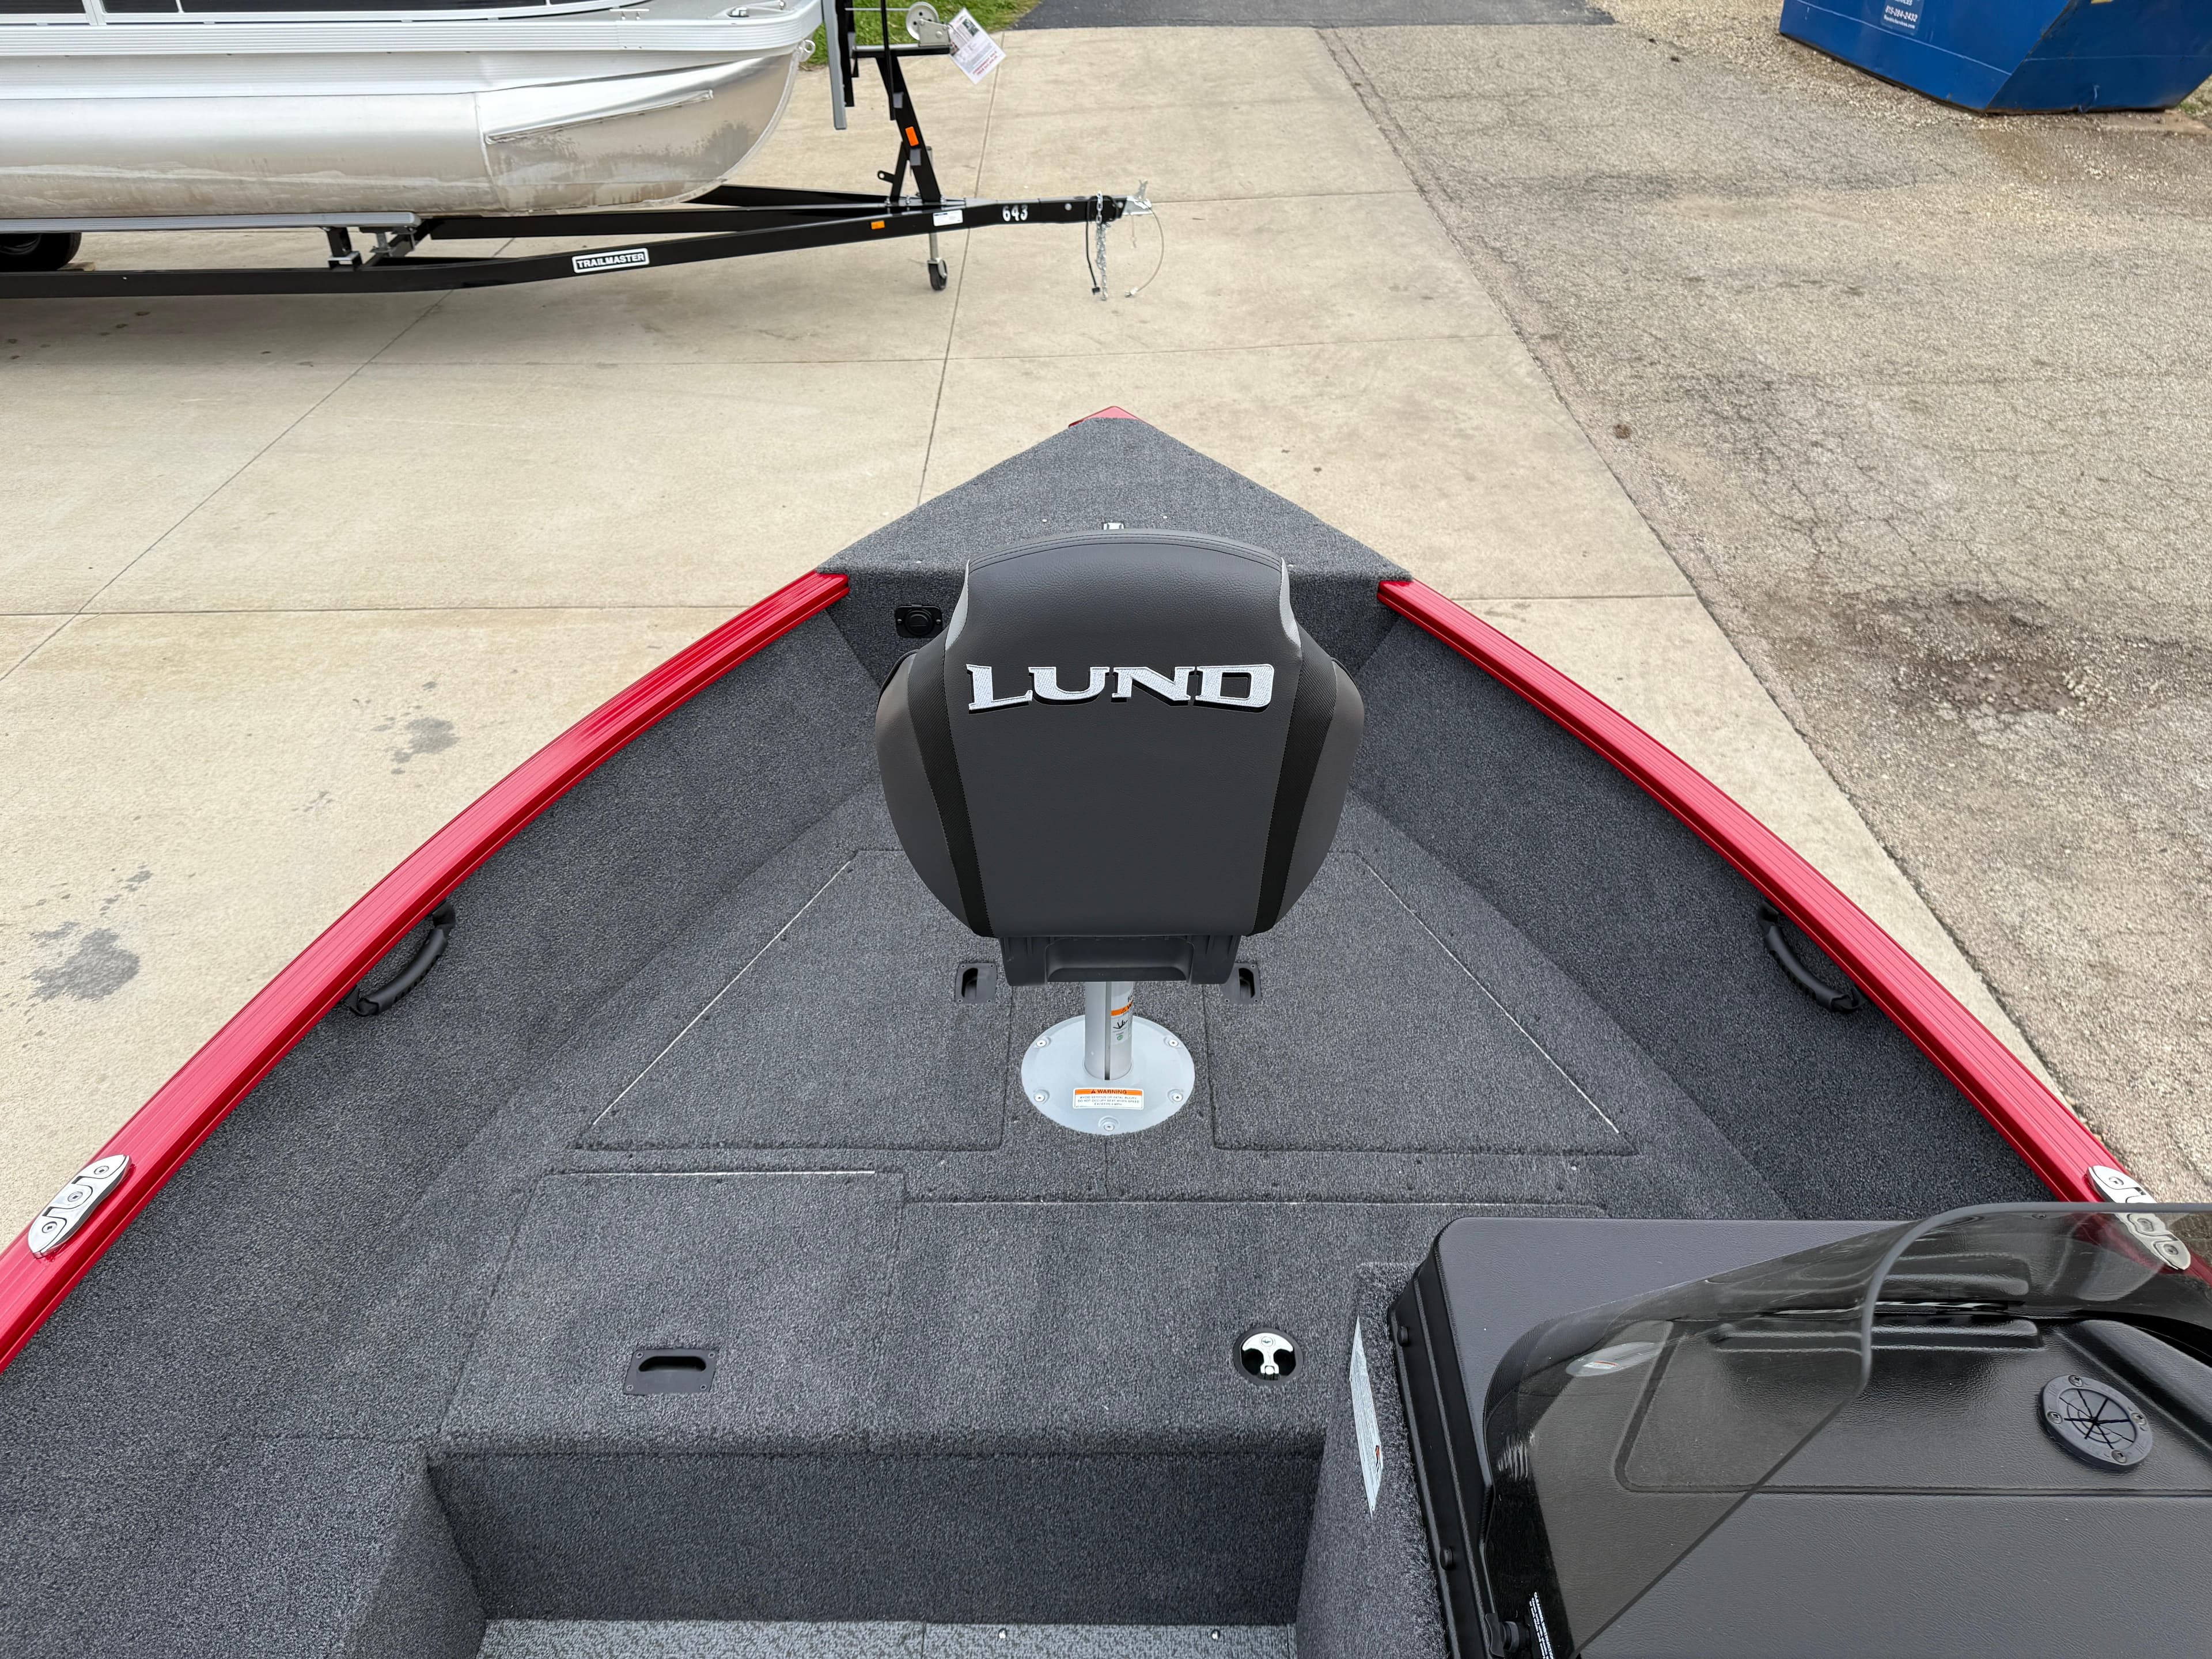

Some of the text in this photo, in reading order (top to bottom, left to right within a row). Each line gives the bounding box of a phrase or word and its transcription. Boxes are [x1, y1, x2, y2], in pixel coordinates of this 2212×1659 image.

[1002, 204, 1028, 222] 643
[577, 253, 645, 268] TRAILMASTER
[966, 664, 1275, 713] LUND
